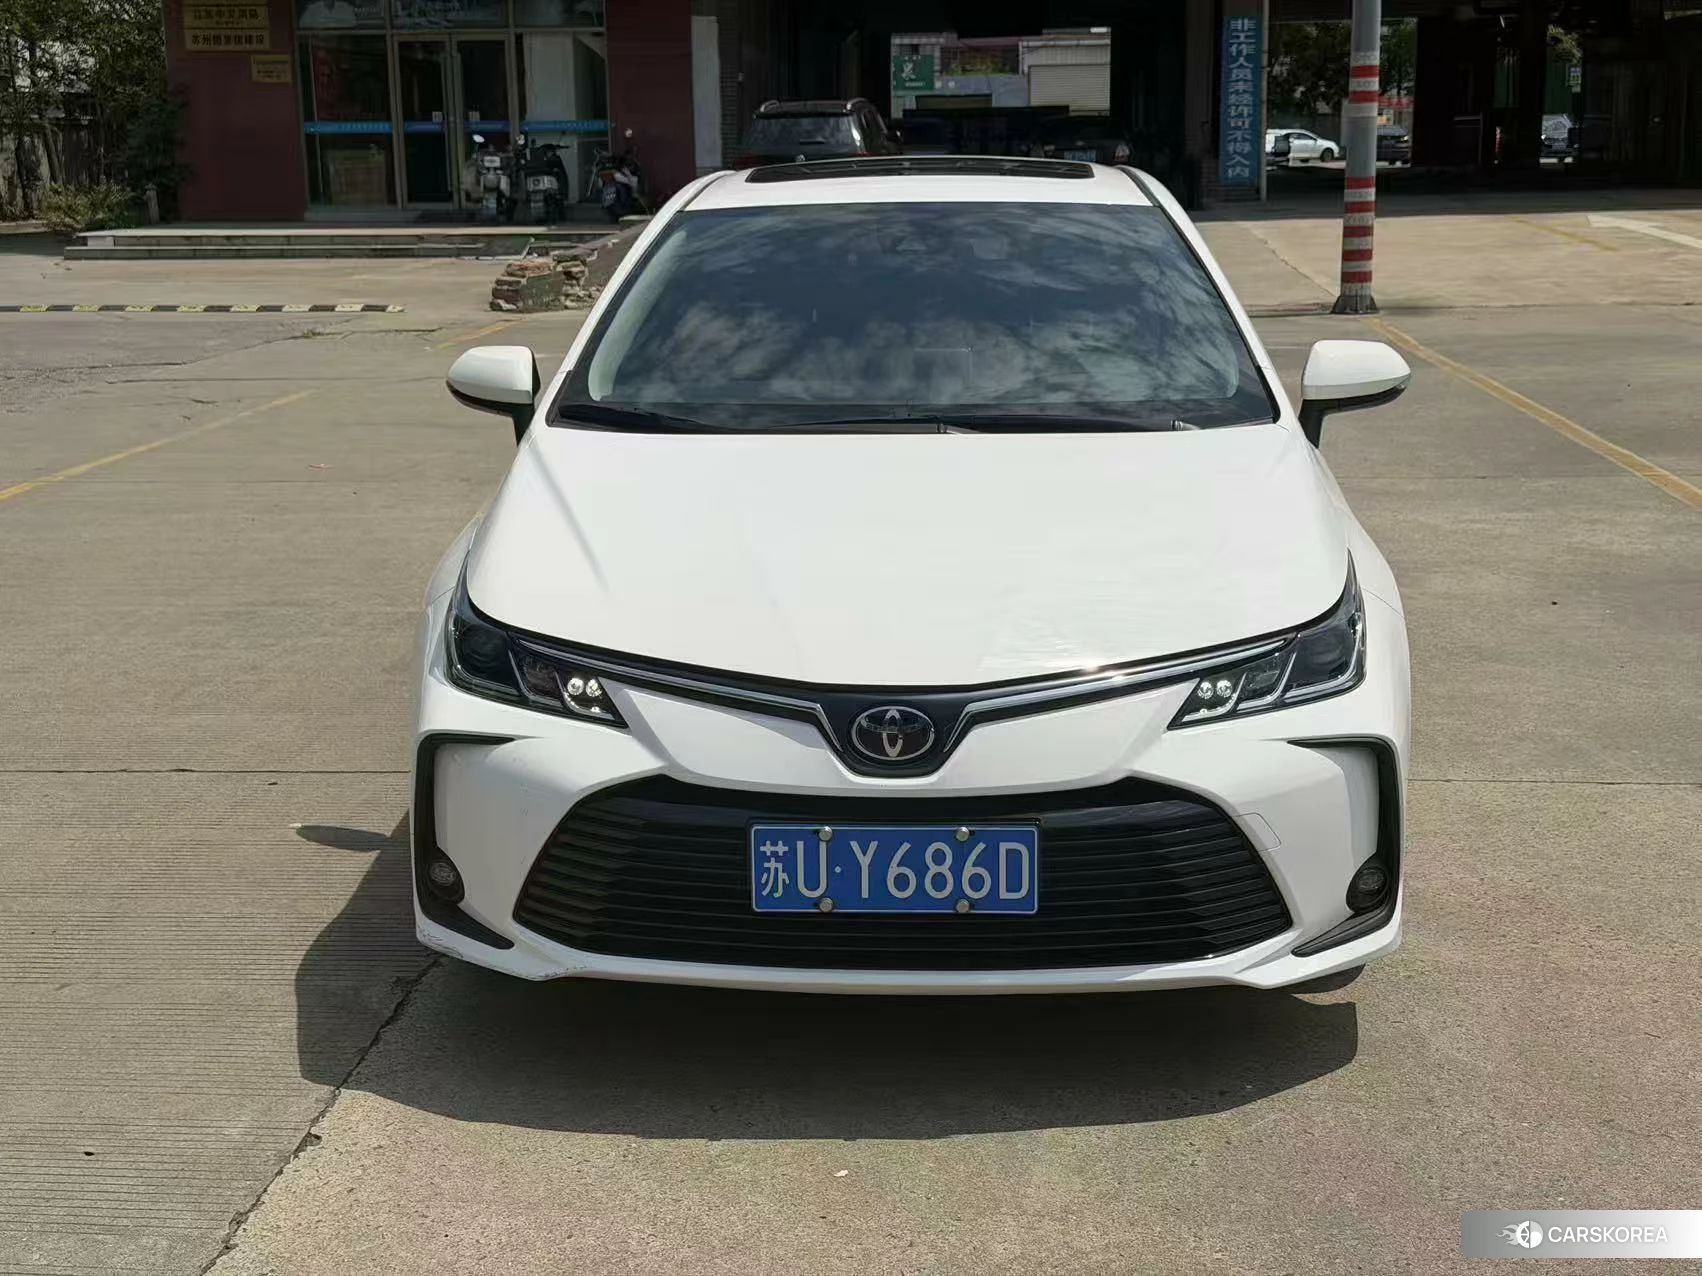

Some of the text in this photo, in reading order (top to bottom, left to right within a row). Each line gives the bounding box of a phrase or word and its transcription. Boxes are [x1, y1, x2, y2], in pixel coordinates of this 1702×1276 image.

[1226, 18, 1256, 178] 非工作人员未经许可不得入内
